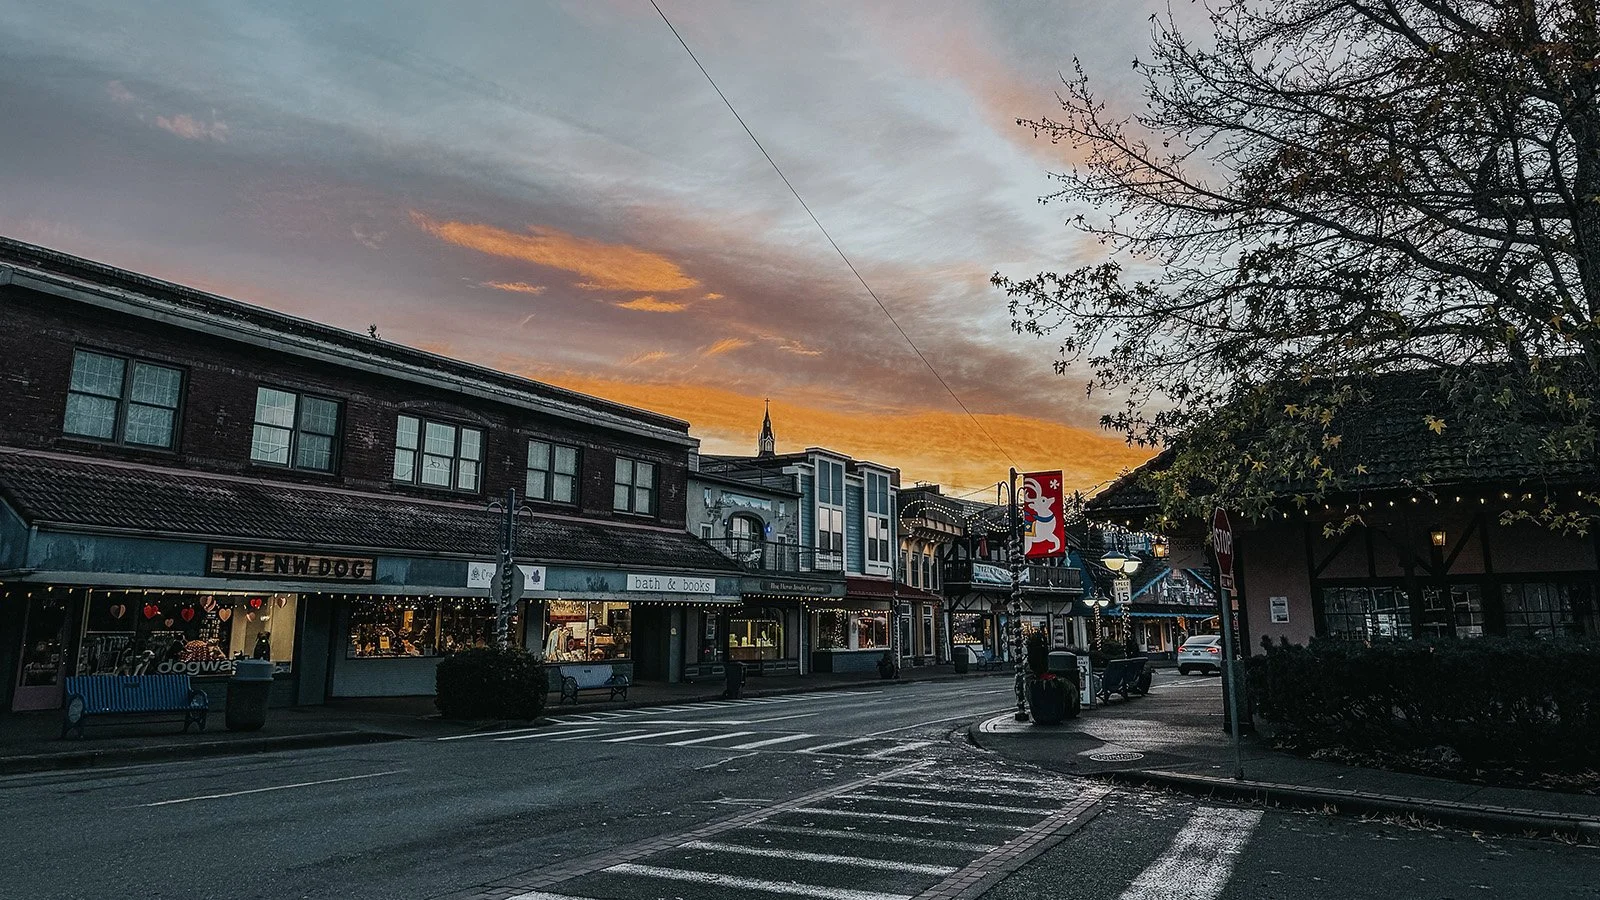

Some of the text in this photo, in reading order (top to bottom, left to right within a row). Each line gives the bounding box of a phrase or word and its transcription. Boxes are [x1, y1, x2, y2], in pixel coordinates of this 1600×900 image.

[1215, 527, 1232, 555] STOP
[222, 551, 366, 579] THE NW DOG
[634, 576, 711, 592] bath & books
[1117, 592, 1130, 602] 15
[157, 658, 238, 675] dogwas
